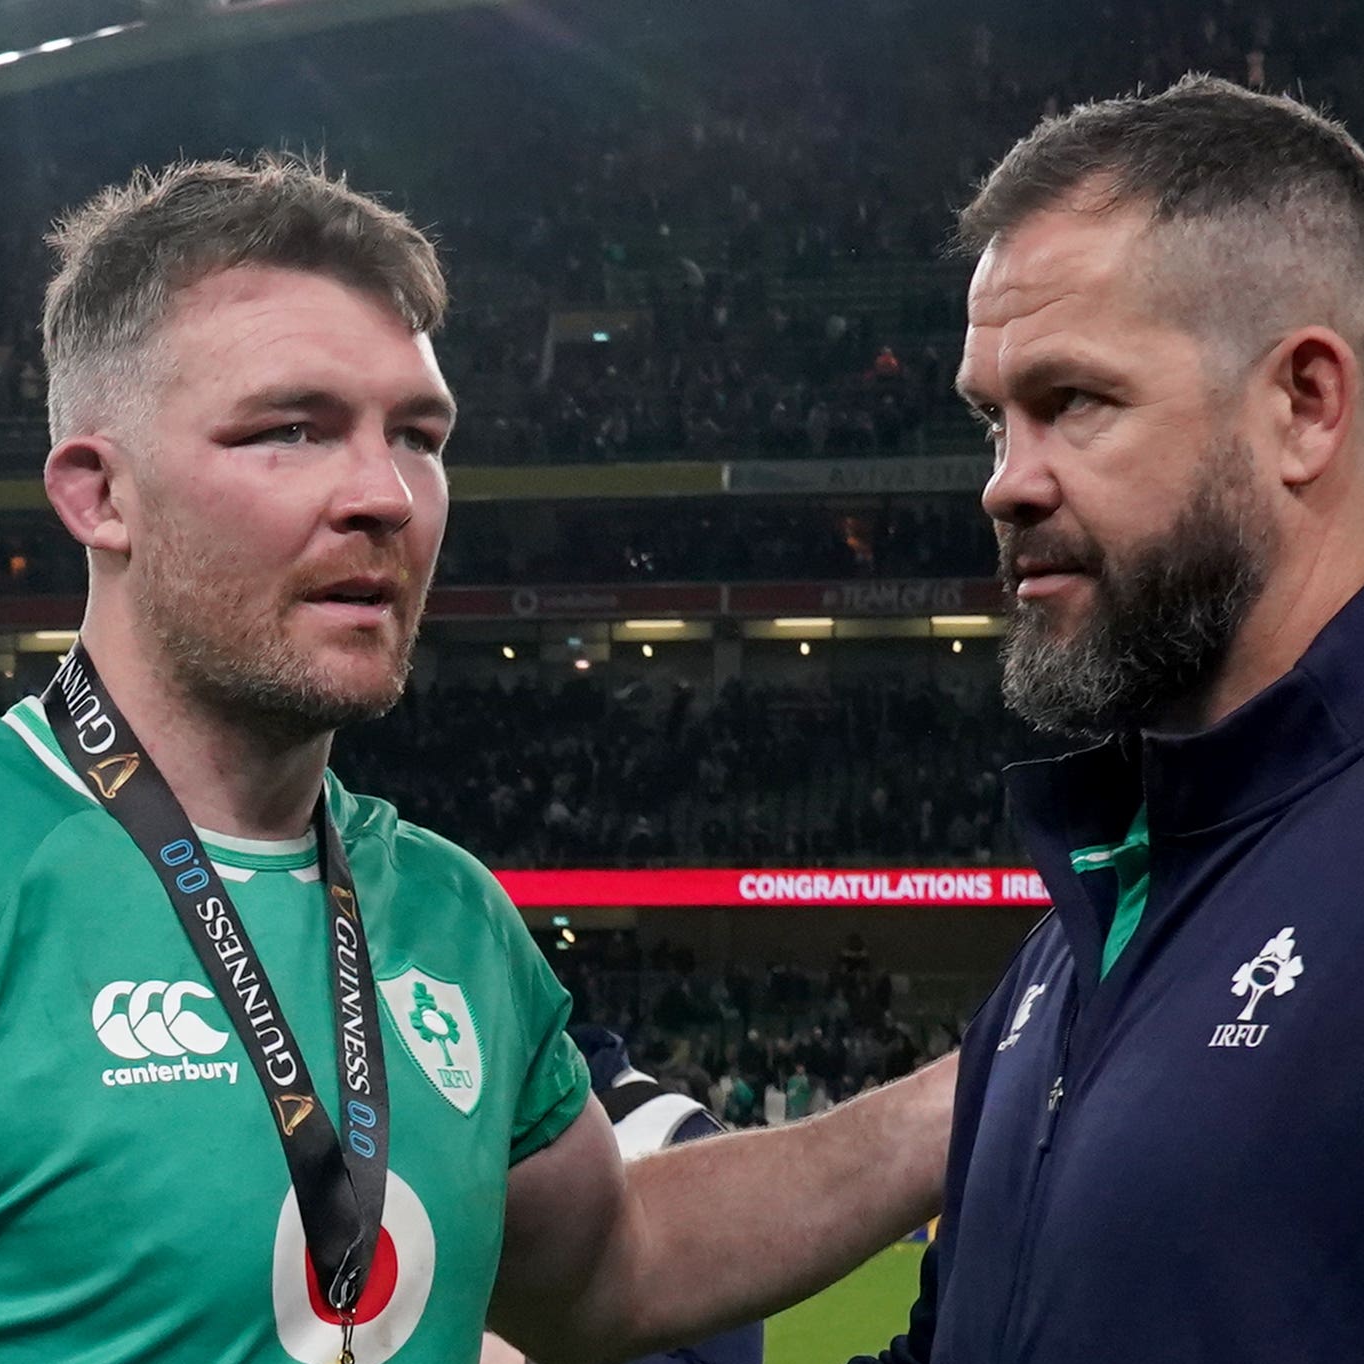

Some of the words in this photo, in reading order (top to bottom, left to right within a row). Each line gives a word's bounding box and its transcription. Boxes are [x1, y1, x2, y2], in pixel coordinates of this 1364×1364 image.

[739, 873, 992, 900] CONGRATULATIONS
[1001, 873, 1051, 900] IRE
[195, 896, 298, 1087] GUINNESS
[332, 916, 371, 1096] GUINNESS
[1208, 1024, 1269, 1048] IRFU
[101, 1057, 238, 1086] canterbury
